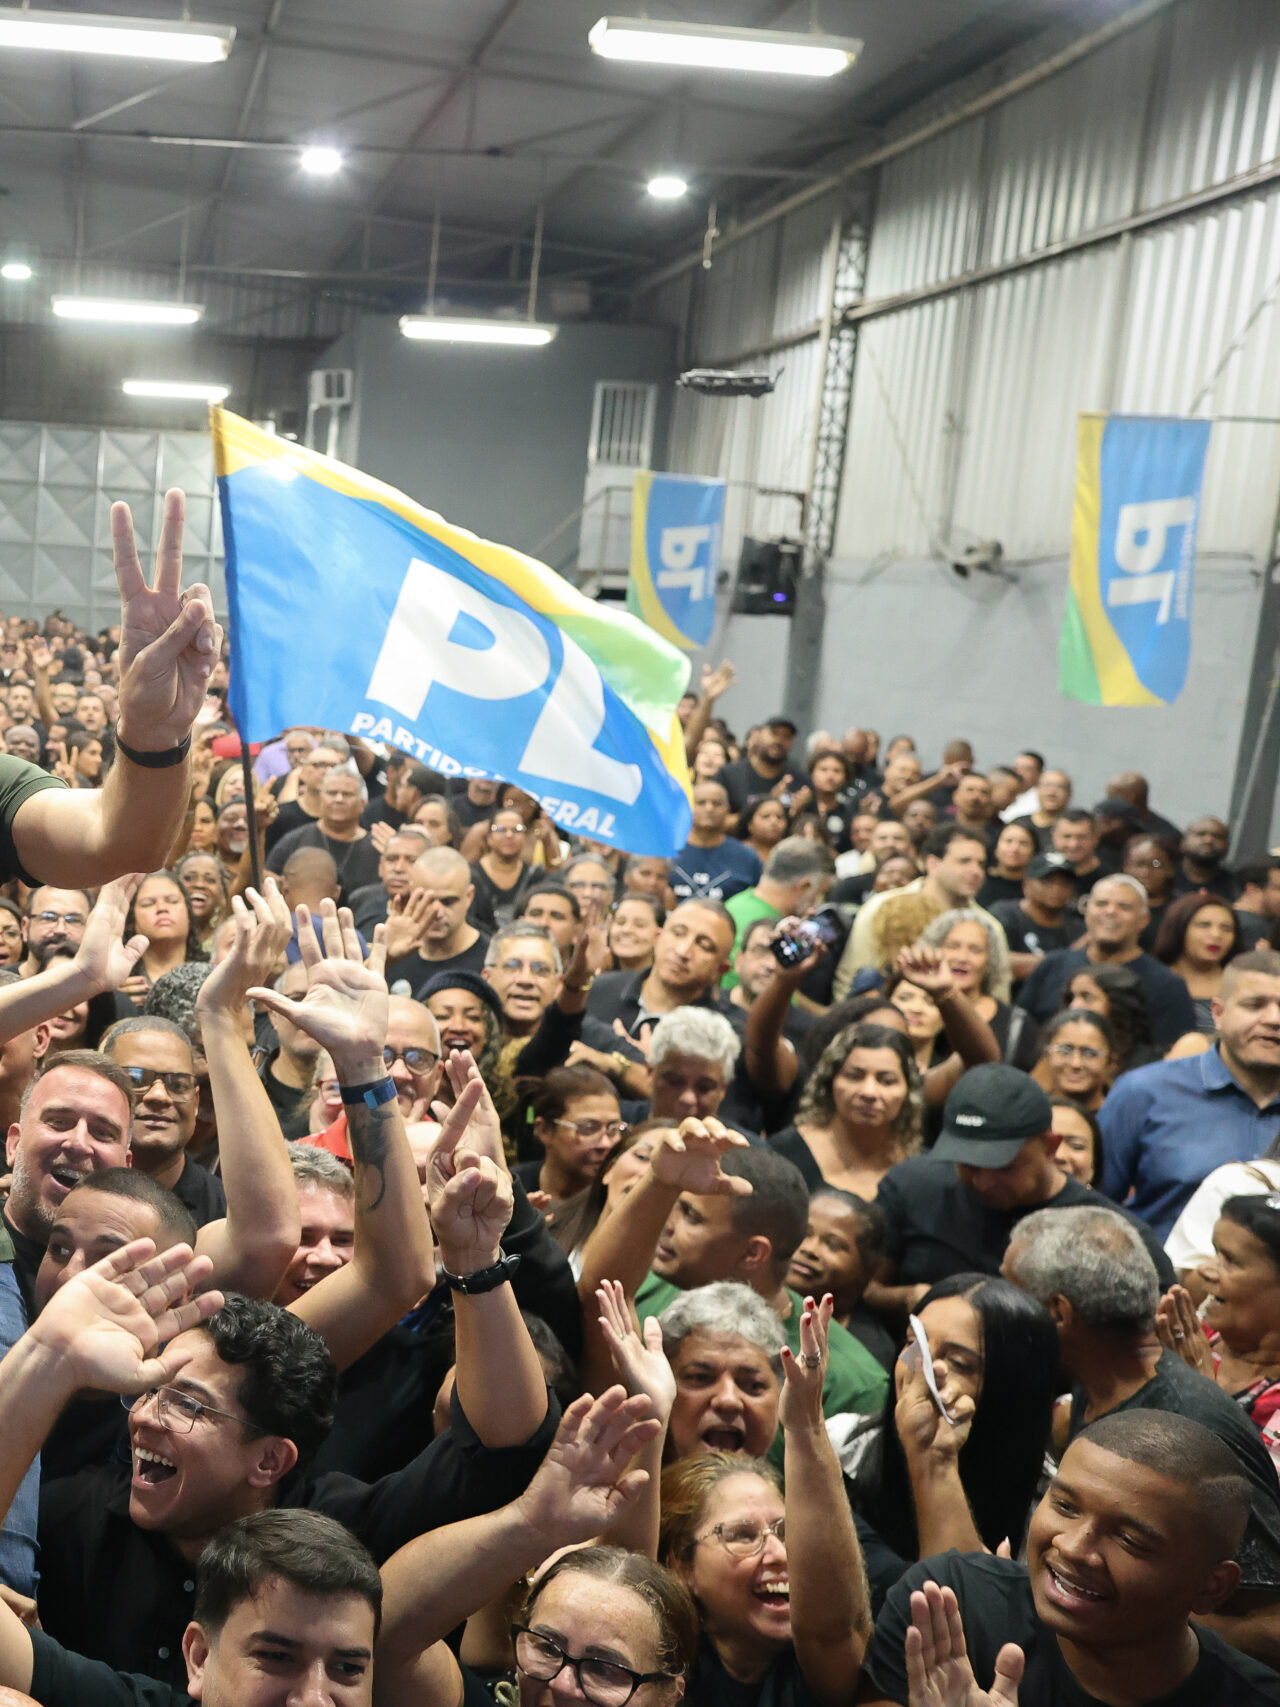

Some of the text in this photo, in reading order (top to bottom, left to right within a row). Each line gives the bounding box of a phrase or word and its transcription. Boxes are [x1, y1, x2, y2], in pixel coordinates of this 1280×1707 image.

[350, 712, 616, 838] PARTIDO ERAL
[366, 558, 643, 806] PL
